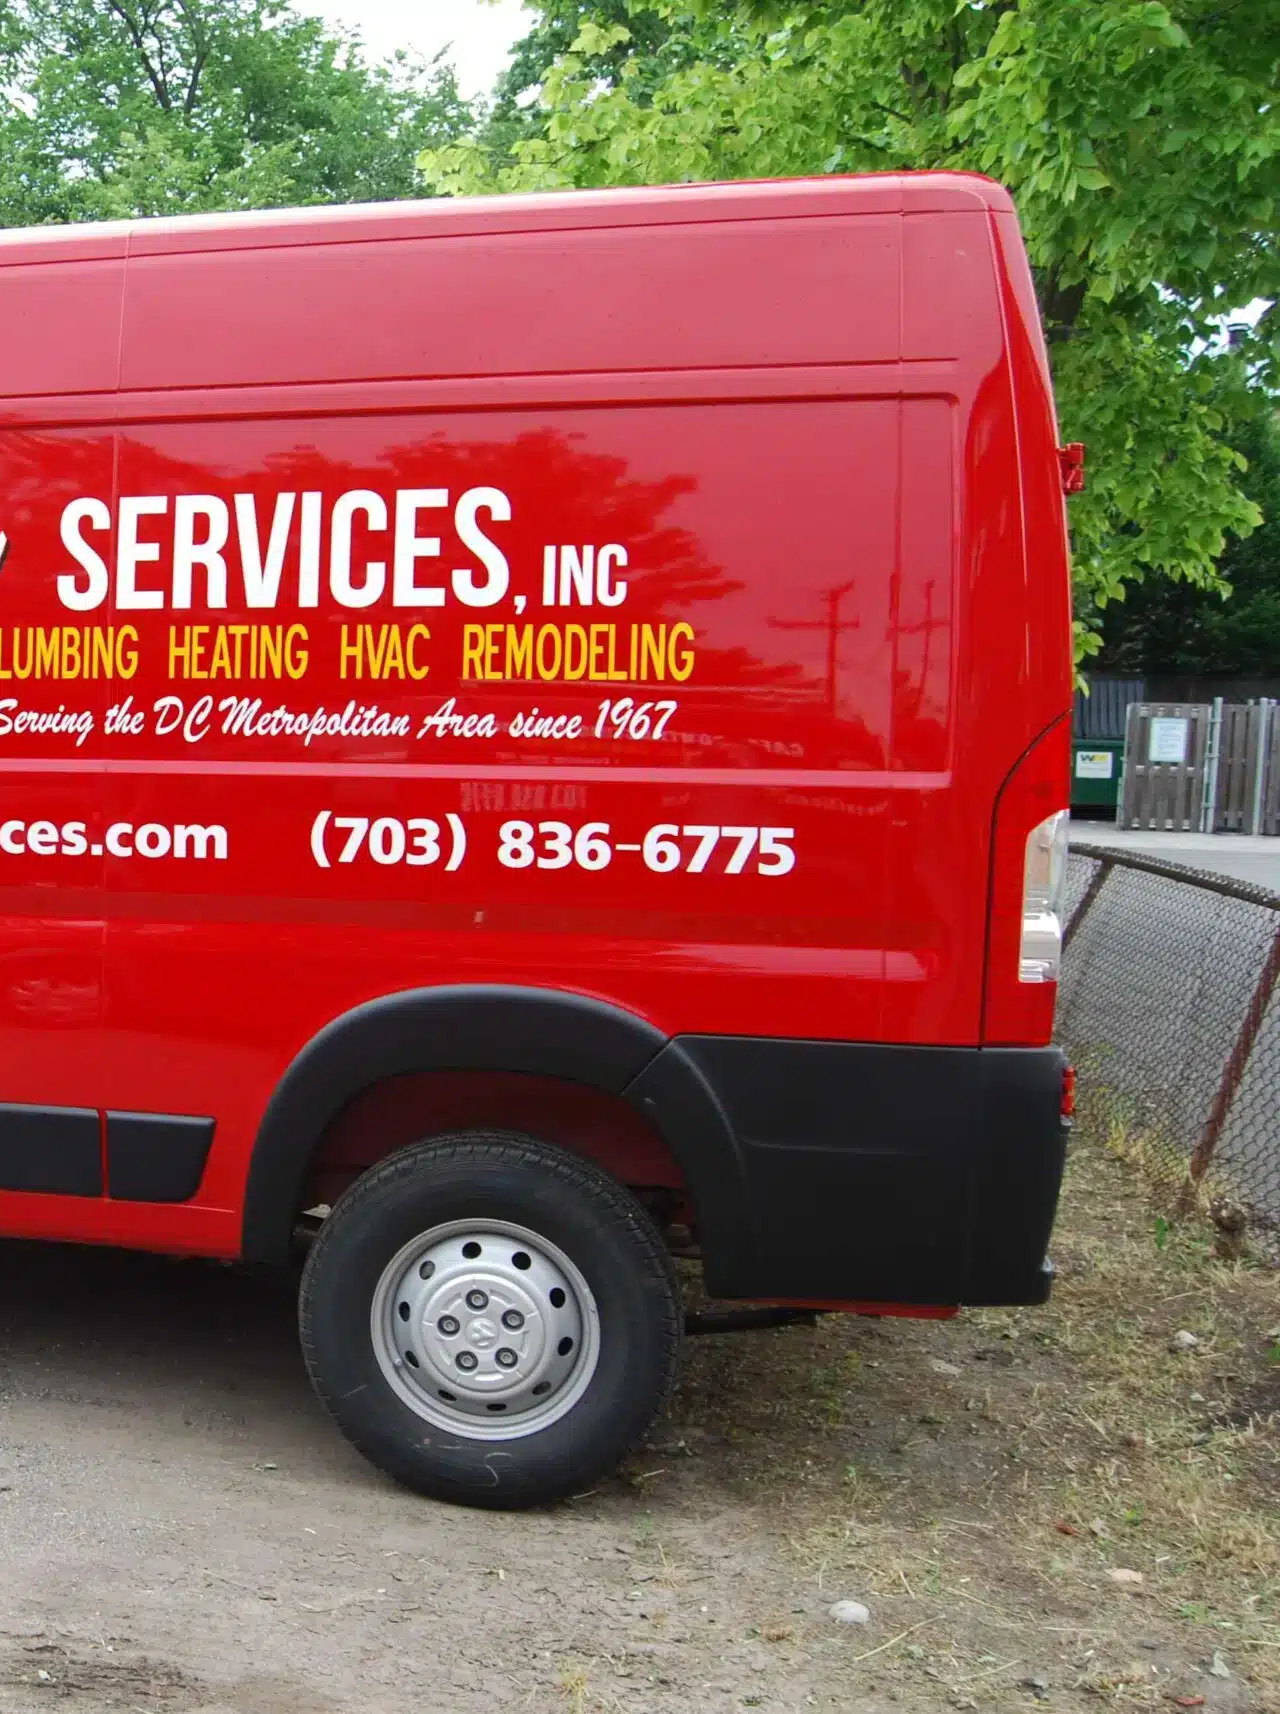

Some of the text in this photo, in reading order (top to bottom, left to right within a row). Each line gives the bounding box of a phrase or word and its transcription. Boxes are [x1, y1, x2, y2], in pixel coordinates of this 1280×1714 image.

[56, 486, 525, 615] SERVICES,
[542, 543, 628, 607] INC
[168, 623, 309, 680] HEATING
[340, 623, 430, 681] HVAC
[462, 622, 695, 681] REMODELING
[103, 695, 145, 735] the
[153, 695, 211, 743] DC
[218, 696, 410, 746] Metropolitan
[416, 697, 497, 740] Area
[509, 707, 582, 740] since
[594, 697, 678, 741] 1967
[311, 810, 796, 876] (703) 836-6775
